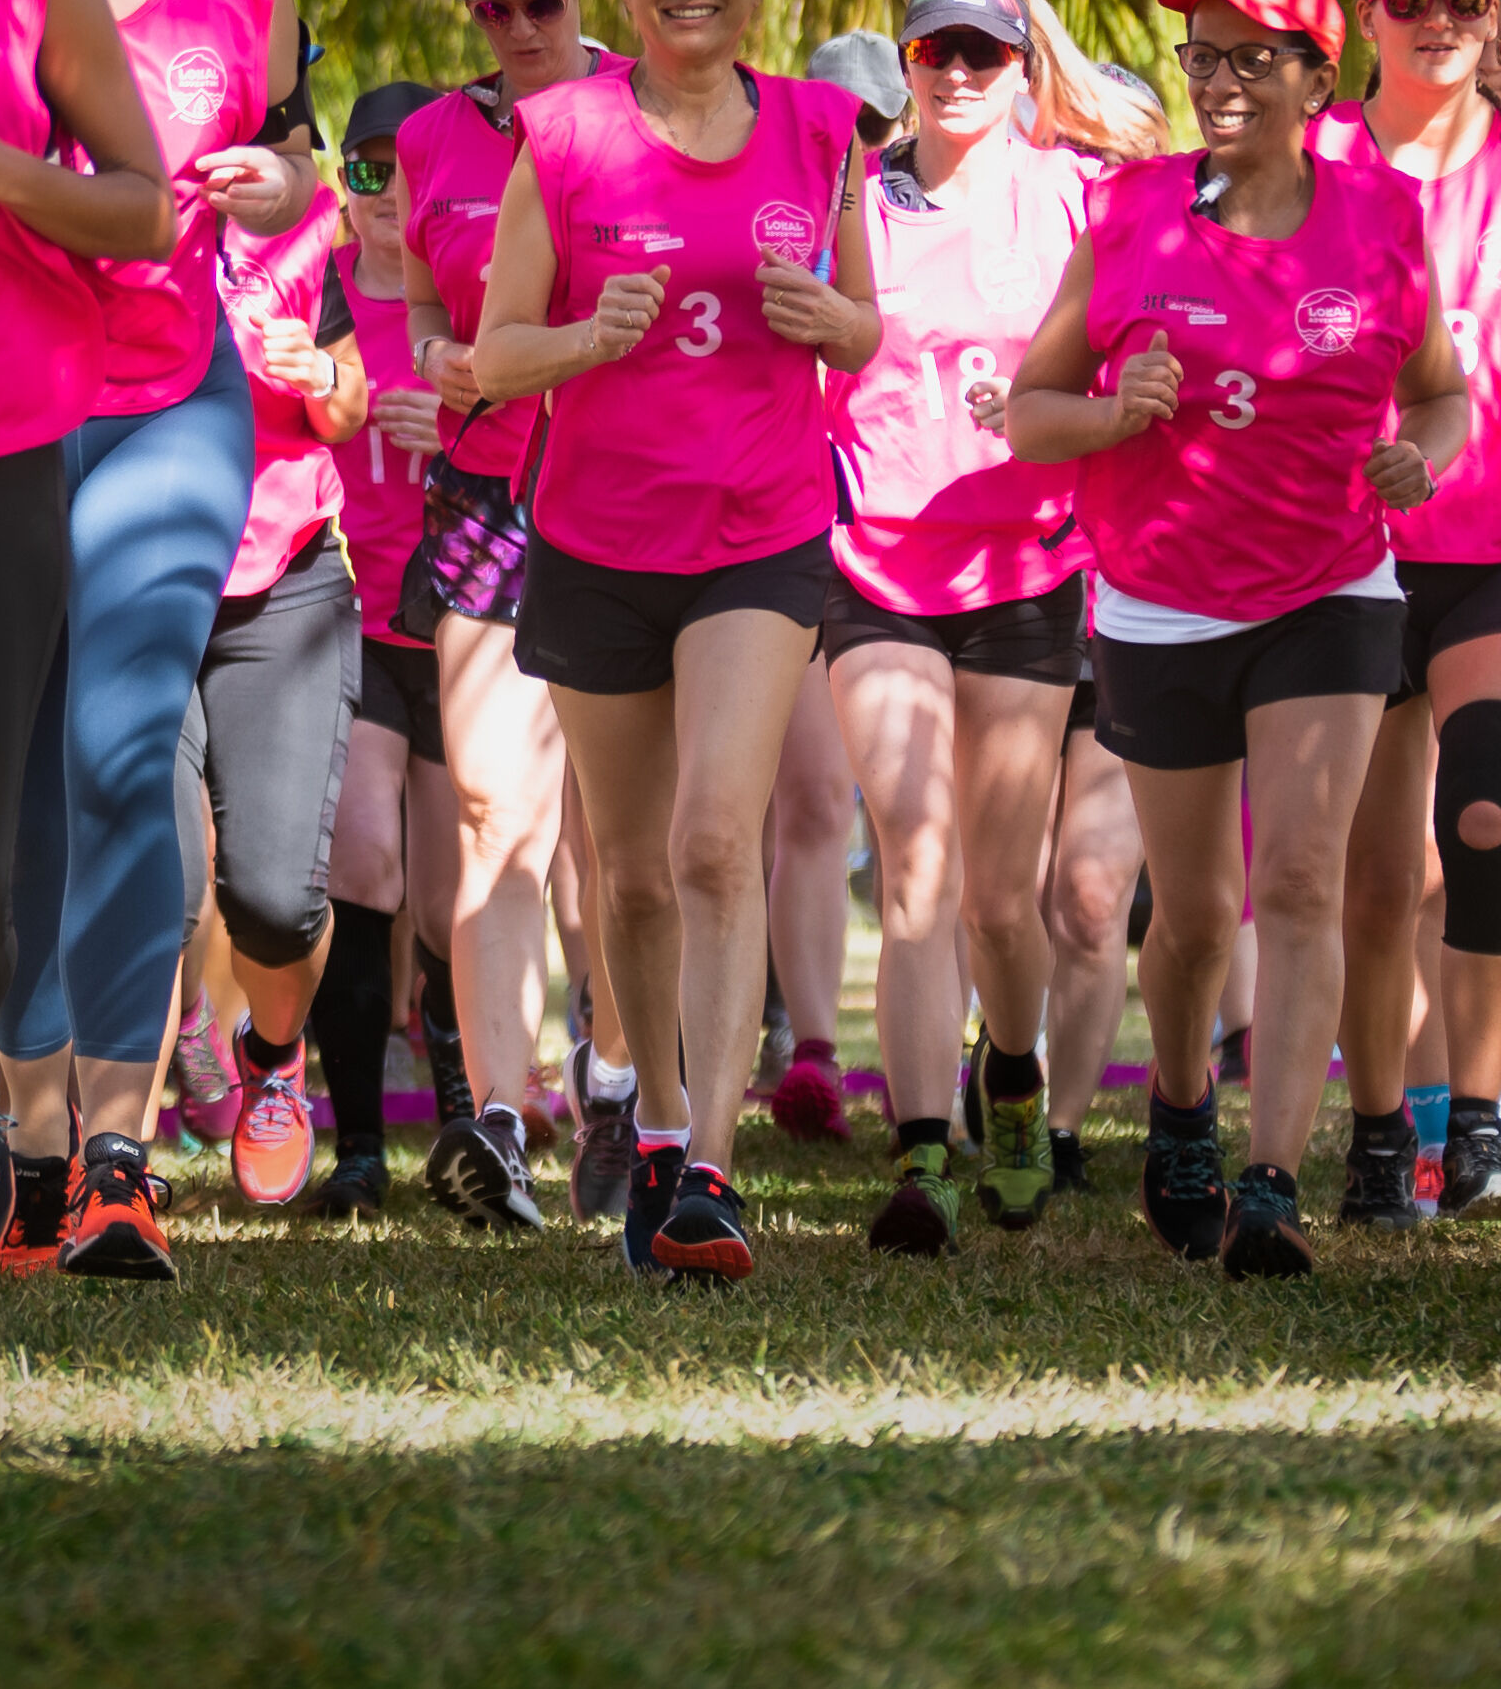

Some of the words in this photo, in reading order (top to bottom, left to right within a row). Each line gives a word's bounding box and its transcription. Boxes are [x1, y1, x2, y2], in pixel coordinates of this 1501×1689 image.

[764, 220, 804, 231] LOKAL
[675, 291, 723, 358] 3
[1308, 306, 1351, 317] LOKAL
[919, 346, 998, 419] 18
[1208, 369, 1257, 430] 3
